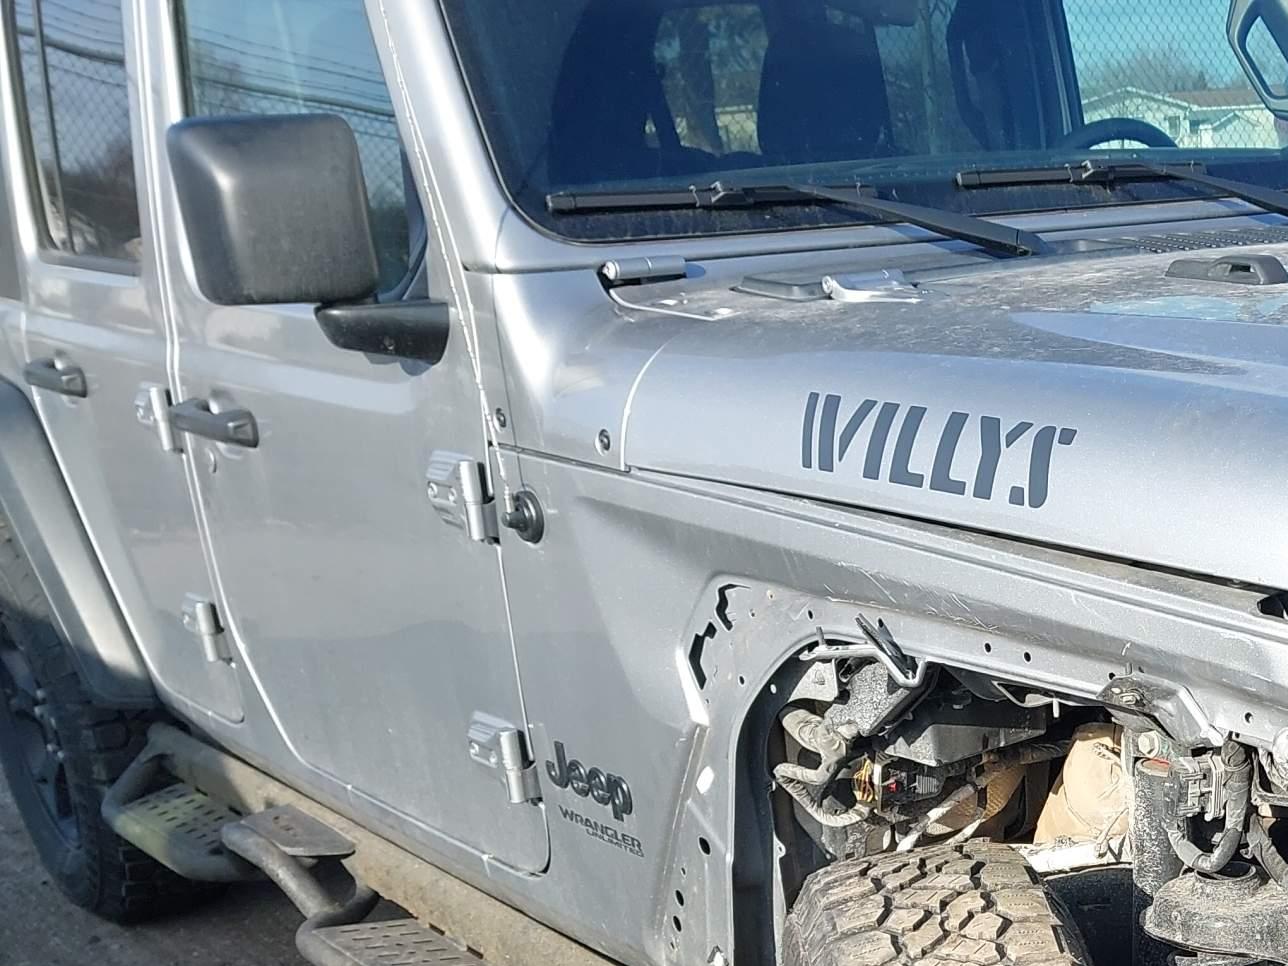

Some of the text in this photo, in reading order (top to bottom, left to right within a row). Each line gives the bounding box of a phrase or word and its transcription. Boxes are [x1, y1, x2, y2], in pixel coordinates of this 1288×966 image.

[801, 391, 1078, 509] WILLYS
[545, 740, 633, 822] Jeep
[558, 804, 643, 850] WRANGLER
[585, 828, 645, 857] UNLIMITED
